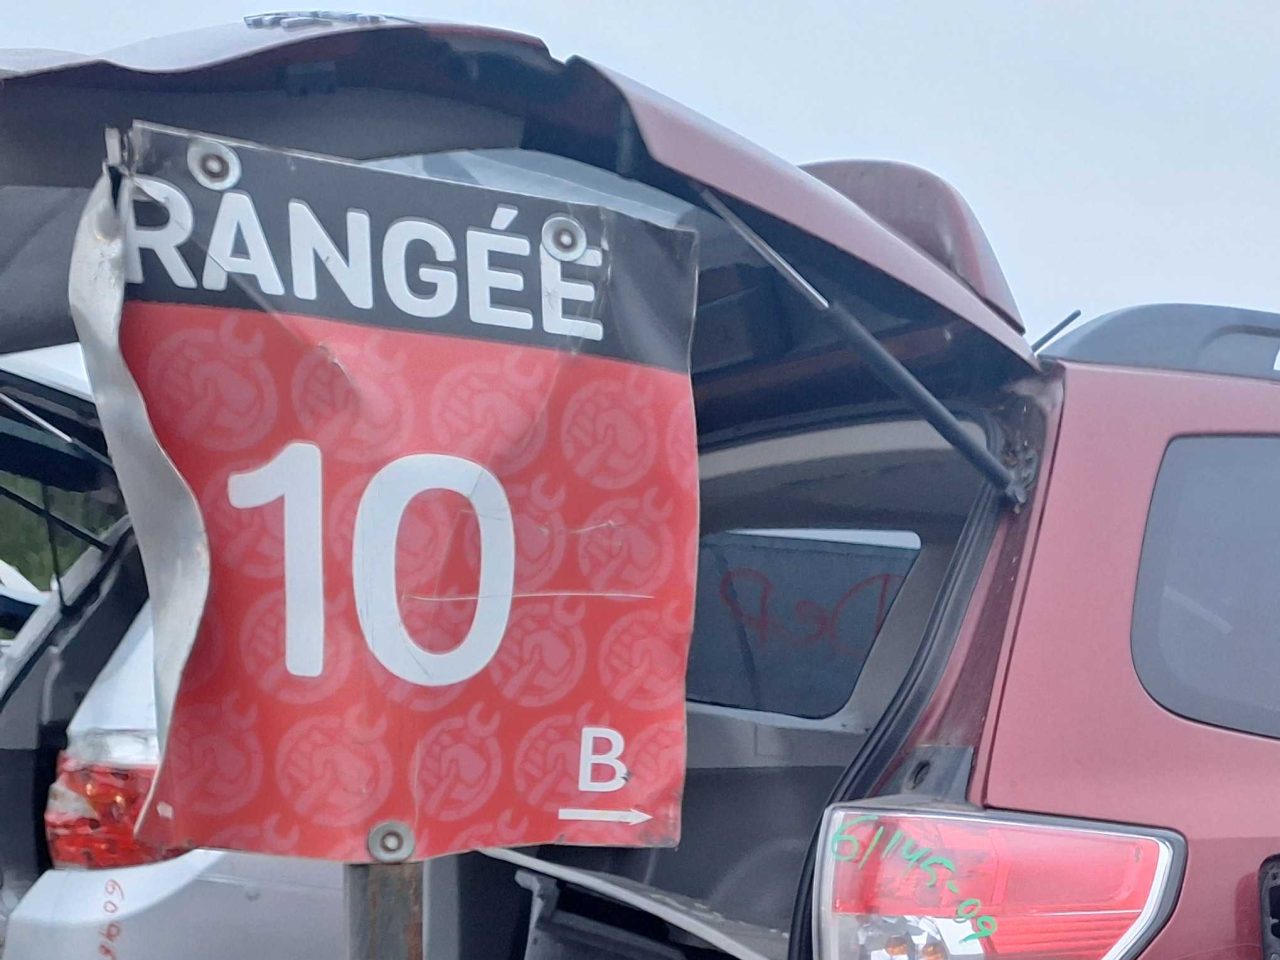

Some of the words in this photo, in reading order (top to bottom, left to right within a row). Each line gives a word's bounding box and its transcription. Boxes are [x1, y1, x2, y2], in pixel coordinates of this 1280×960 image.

[125, 174, 604, 342] RANGÉE
[228, 442, 516, 687] 10
[577, 727, 628, 793] B
[831, 815, 998, 944] 61145-09
